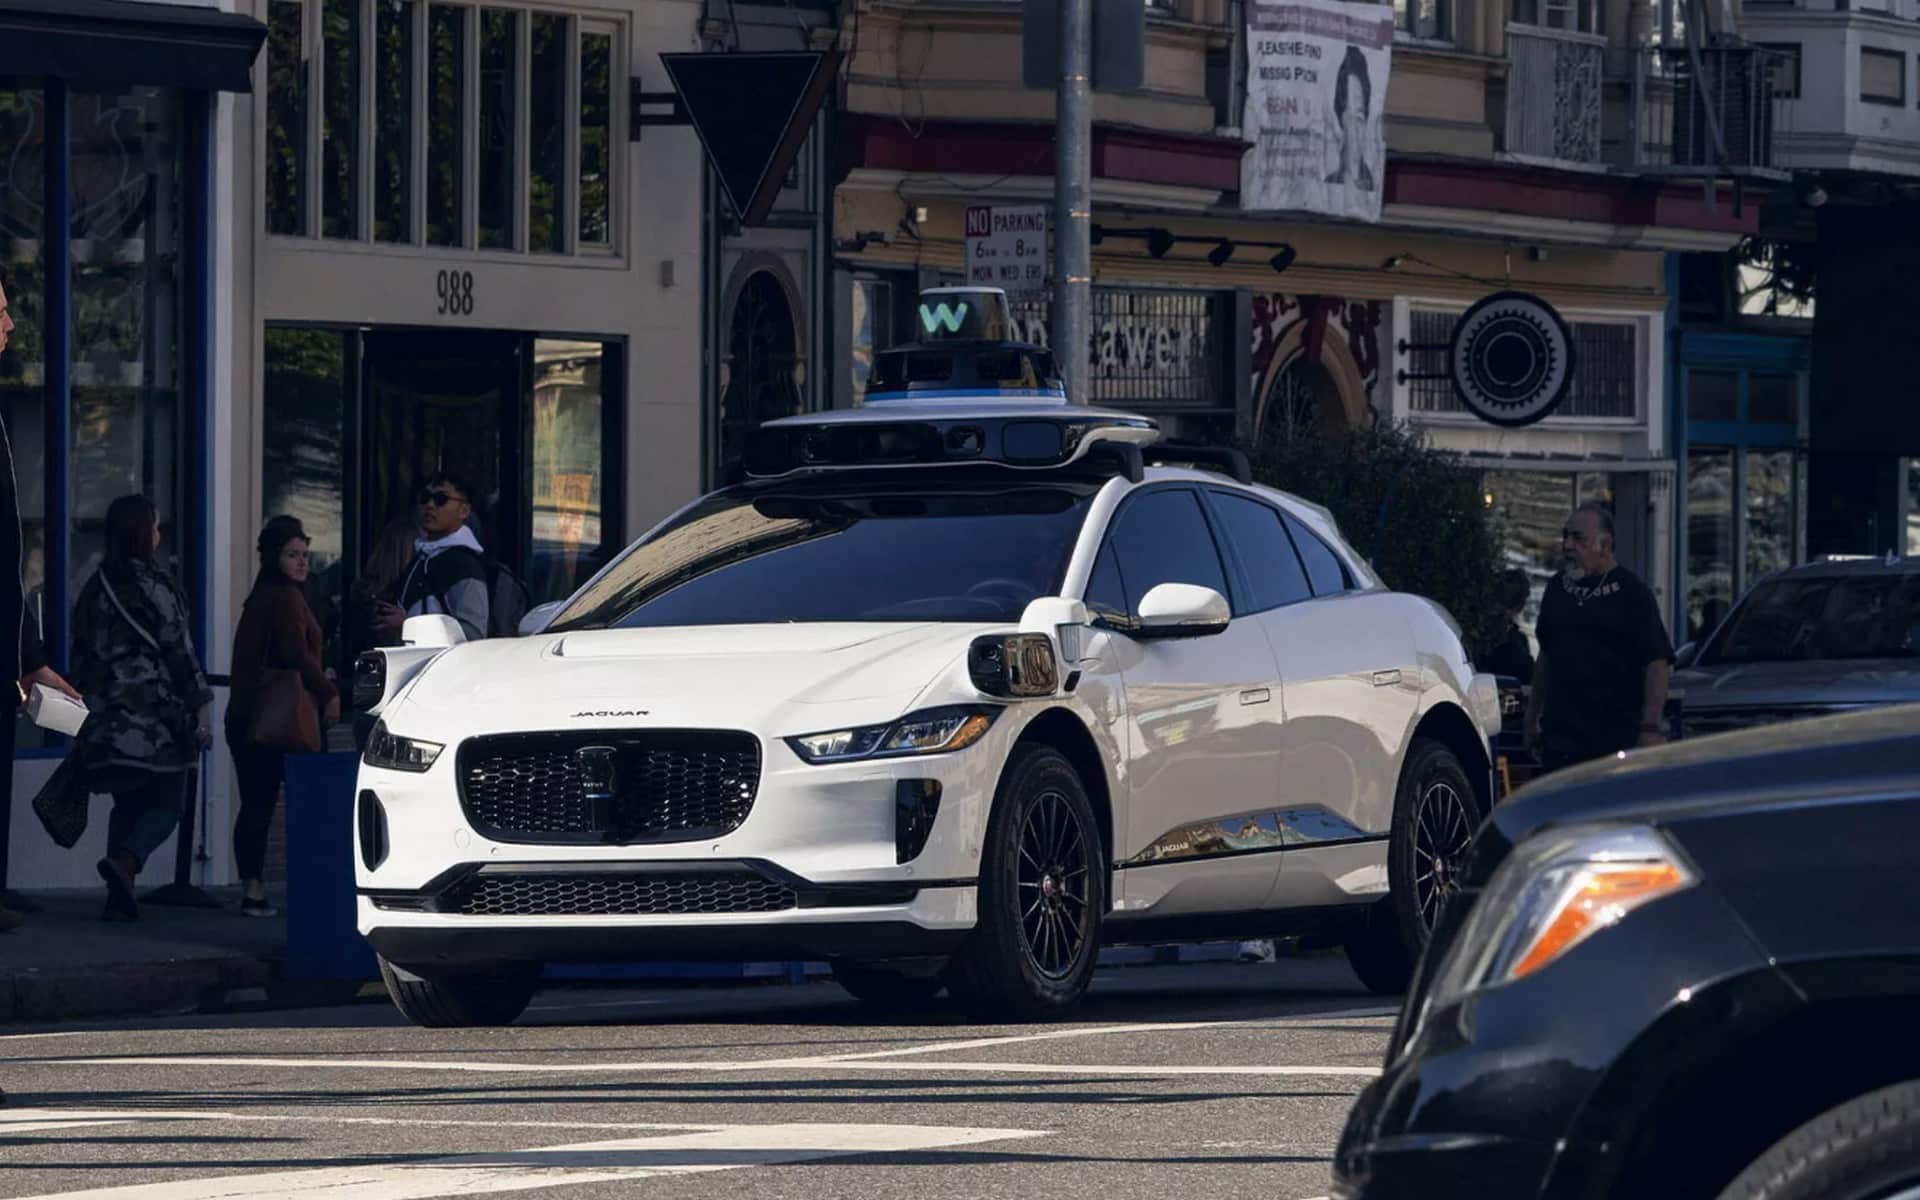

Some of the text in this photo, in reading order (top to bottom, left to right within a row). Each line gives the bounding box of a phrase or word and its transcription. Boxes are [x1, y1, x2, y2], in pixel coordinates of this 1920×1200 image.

[968, 209, 1044, 232] NO PARKING
[437, 269, 473, 315] 988
[1162, 842, 1189, 852] JAGUAR
